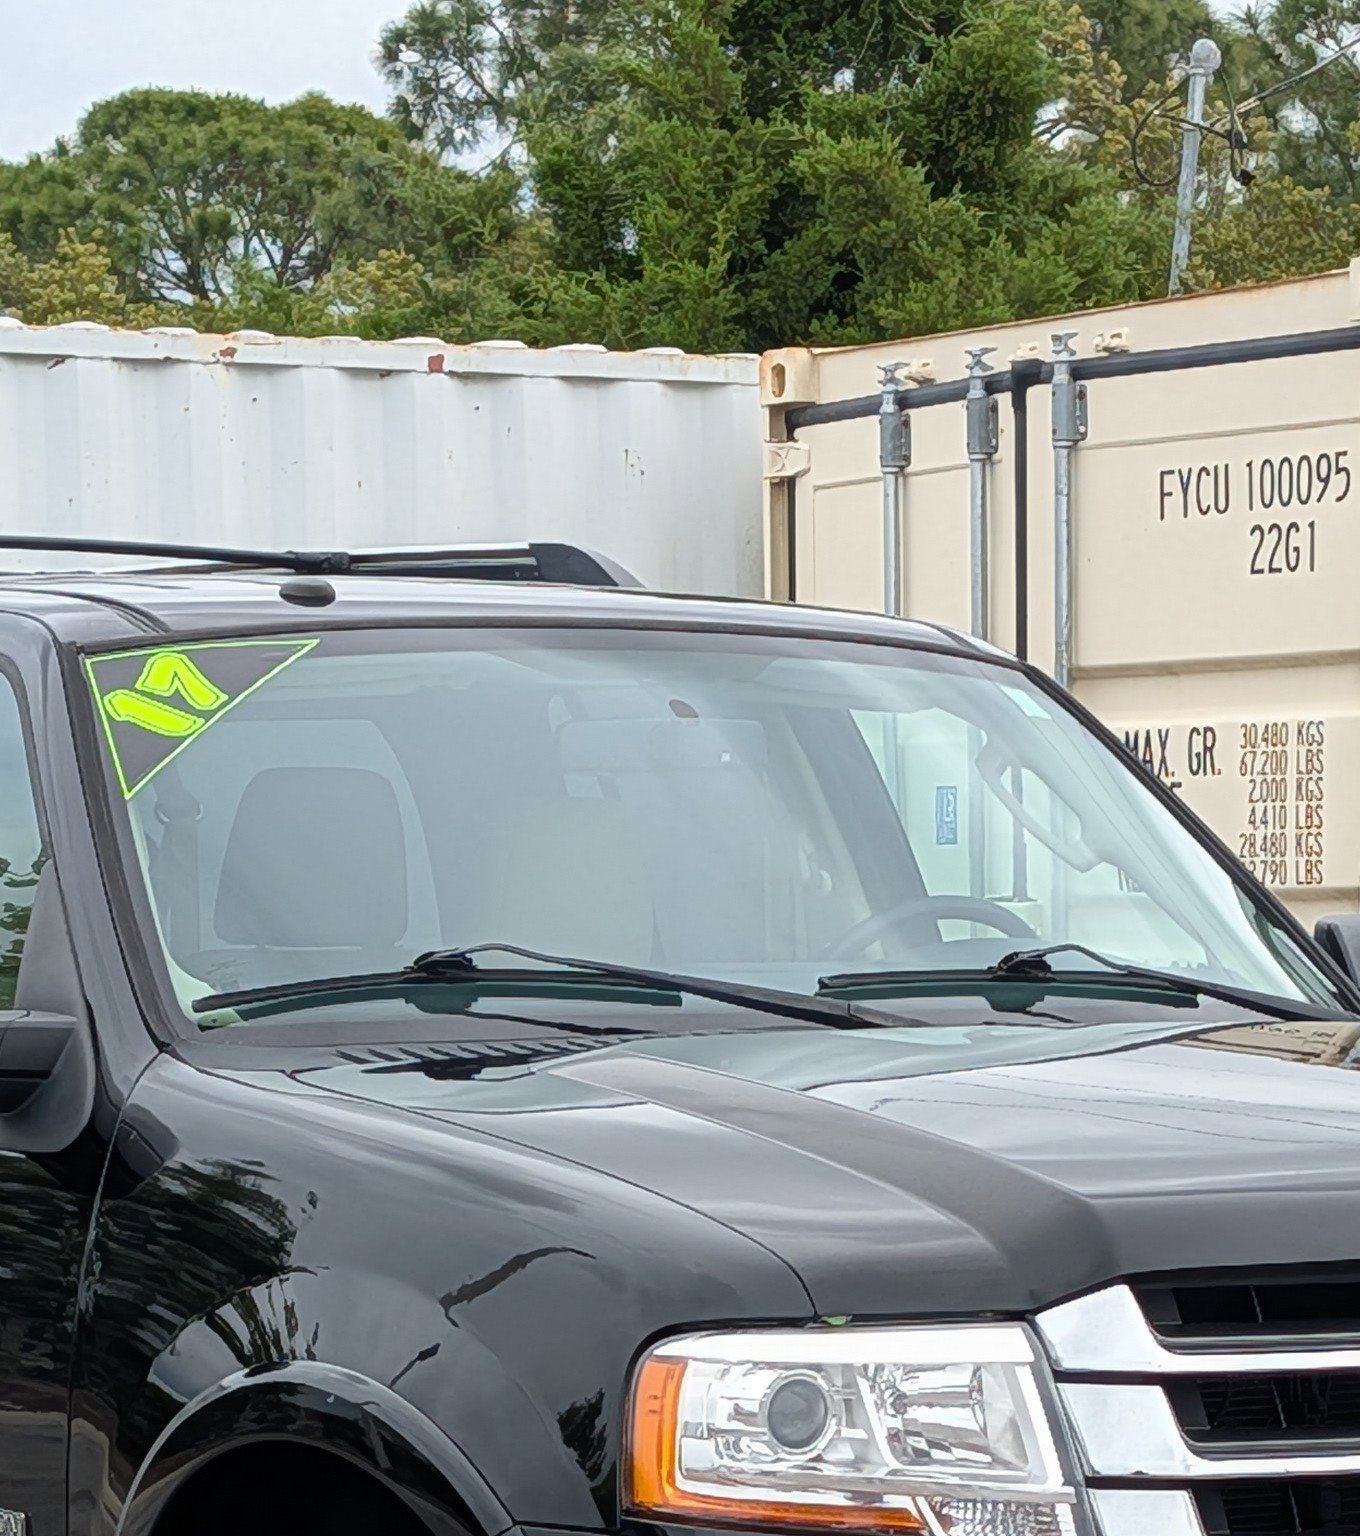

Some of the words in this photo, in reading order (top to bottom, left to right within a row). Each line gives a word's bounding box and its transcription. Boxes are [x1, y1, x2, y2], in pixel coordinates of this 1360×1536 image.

[1159, 463, 1230, 520] FYCU
[1246, 450, 1351, 511] 100095
[1250, 521, 1315, 574] 22G1
[104, 652, 229, 737] 17
[1297, 720, 1325, 747] KGS
[1188, 726, 1221, 777] GR.
[1296, 749, 1324, 775] LBS
[1296, 777, 1324, 802] KGS
[1295, 804, 1324, 830] LBS
[1295, 832, 1324, 857] KGS
[1295, 859, 1324, 885] LBS
